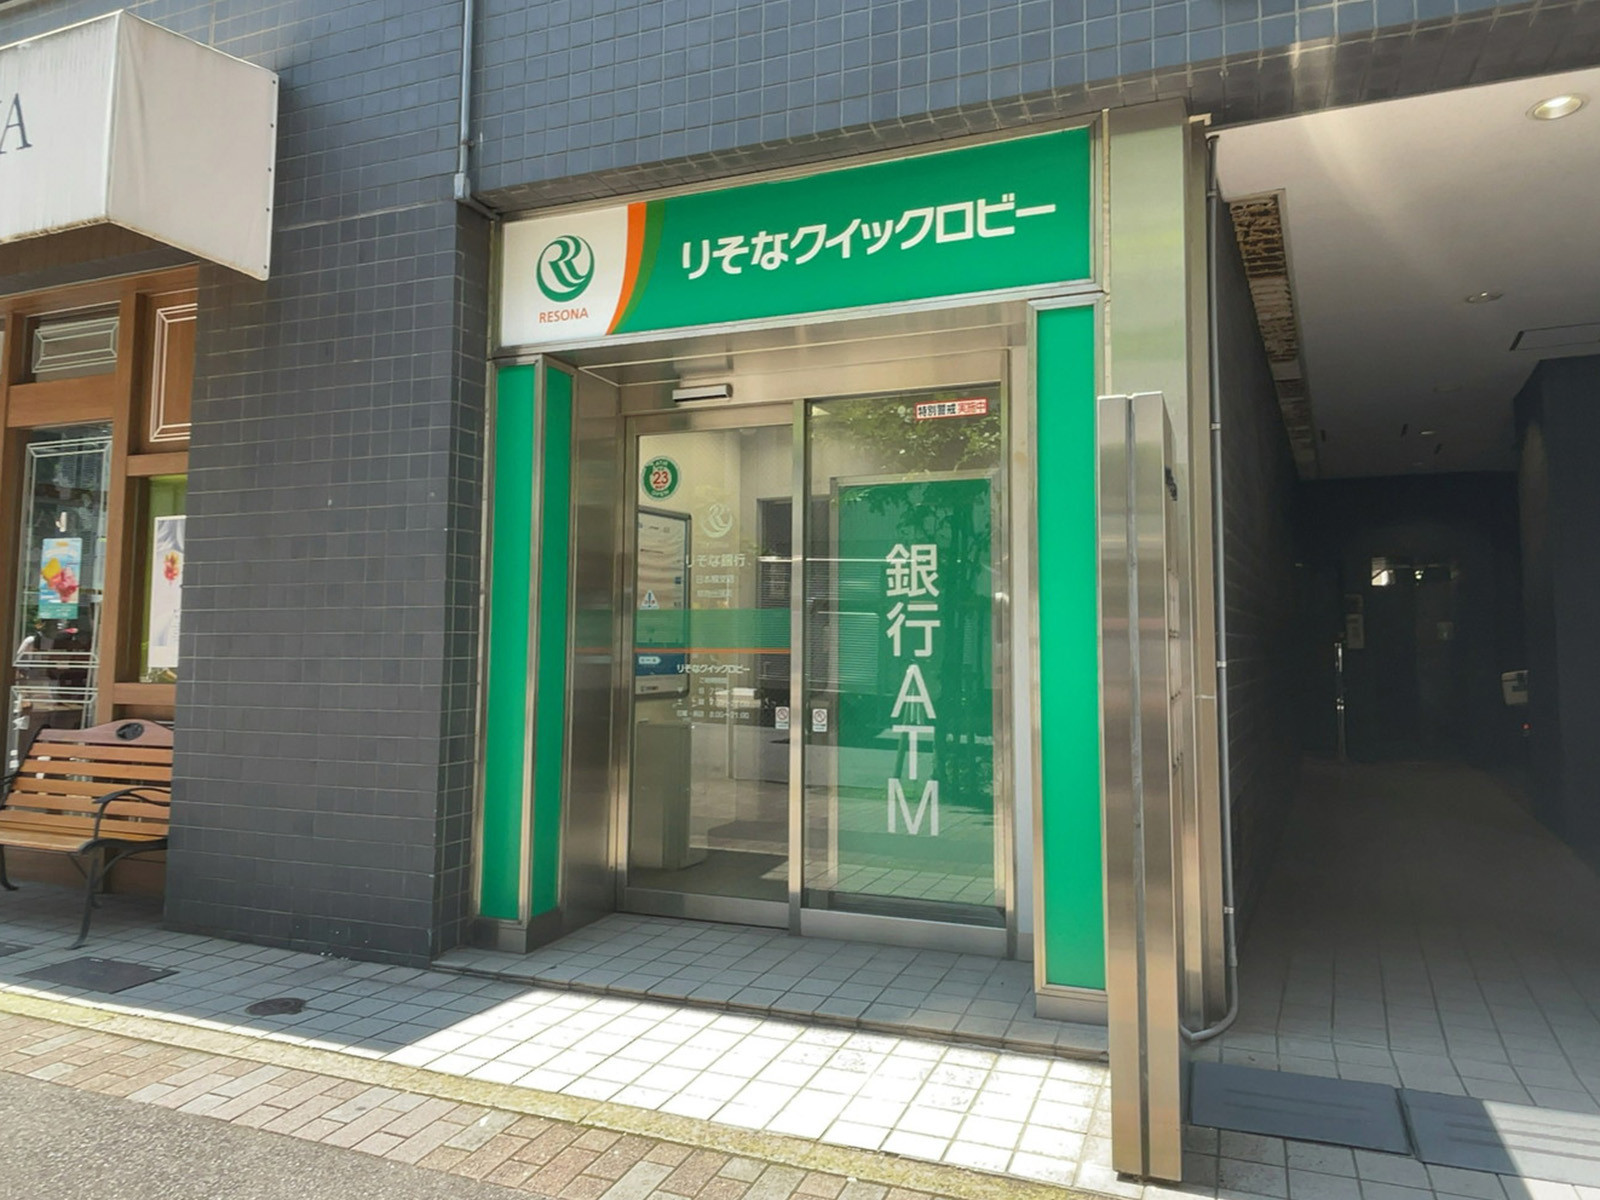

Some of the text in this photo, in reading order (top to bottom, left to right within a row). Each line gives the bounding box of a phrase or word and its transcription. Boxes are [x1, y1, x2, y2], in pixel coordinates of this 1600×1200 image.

[0, 92, 33, 154] A
[682, 193, 1056, 279] りそなクイックロビー
[539, 308, 589, 324] RESONA
[652, 471, 669, 485] 23
[685, 554, 746, 568] りそな銀行
[886, 544, 941, 837] 銀行ATM
